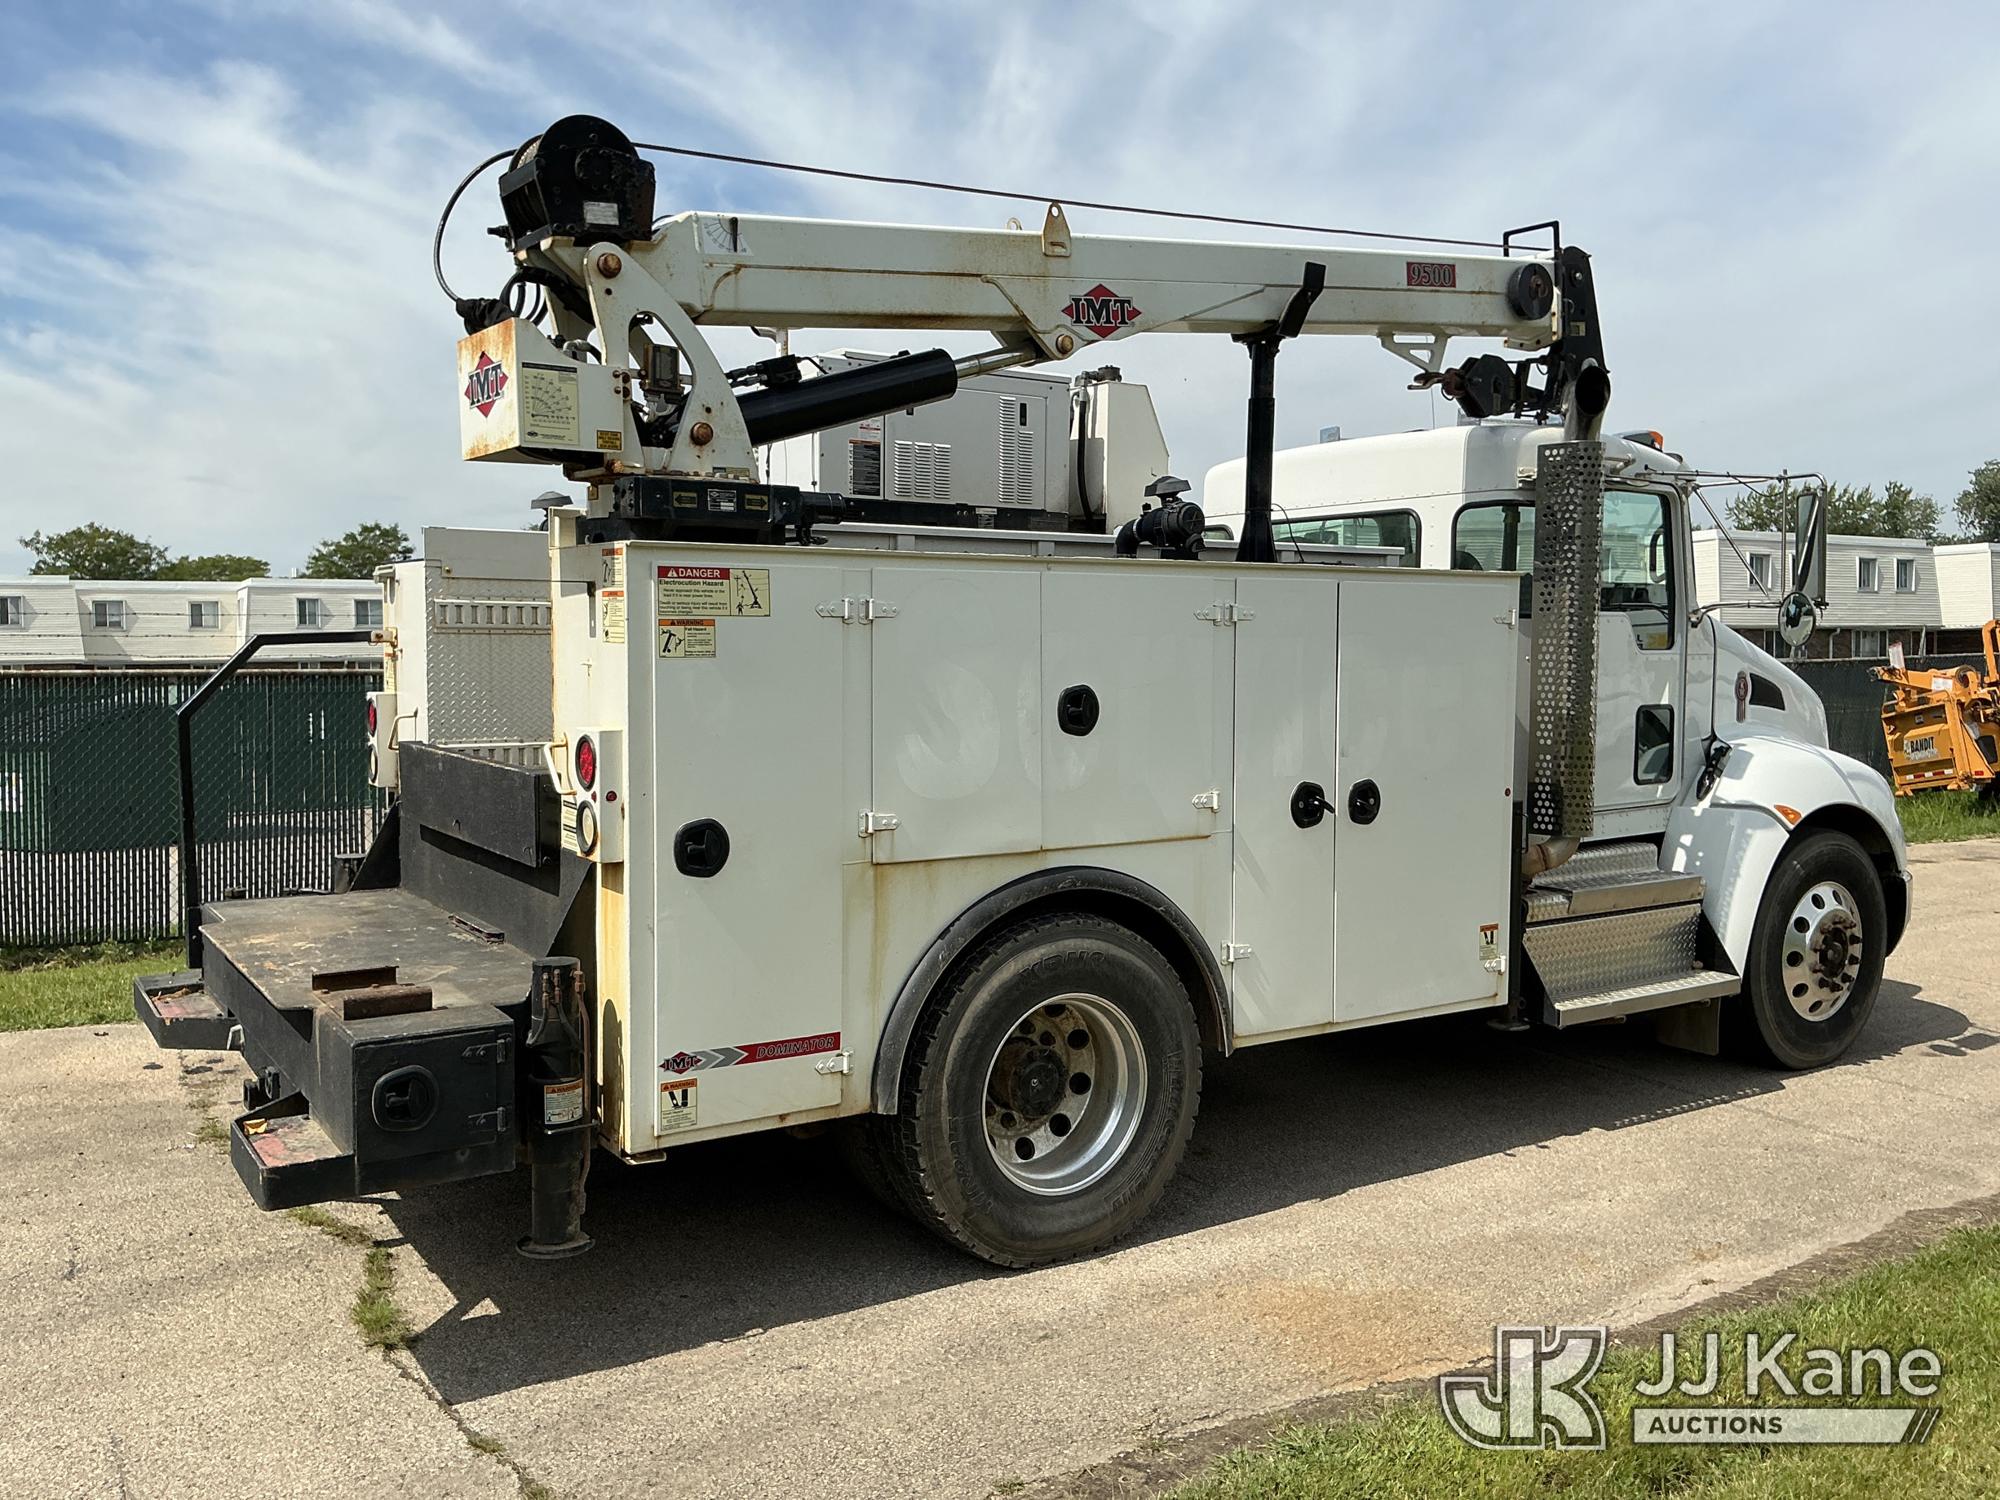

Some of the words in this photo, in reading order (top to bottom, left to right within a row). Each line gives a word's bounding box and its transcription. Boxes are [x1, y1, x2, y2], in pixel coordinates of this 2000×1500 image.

[1411, 264, 1453, 287] 9500
[1071, 297, 1132, 326] IMT
[468, 361, 503, 408] IMT
[678, 569, 721, 578] DANGER
[1910, 736, 1934, 753] BANDIT
[756, 1037, 835, 1059] DOMINATOR
[664, 1055, 698, 1072] IMT
[670, 1080, 695, 1089] WARNING
